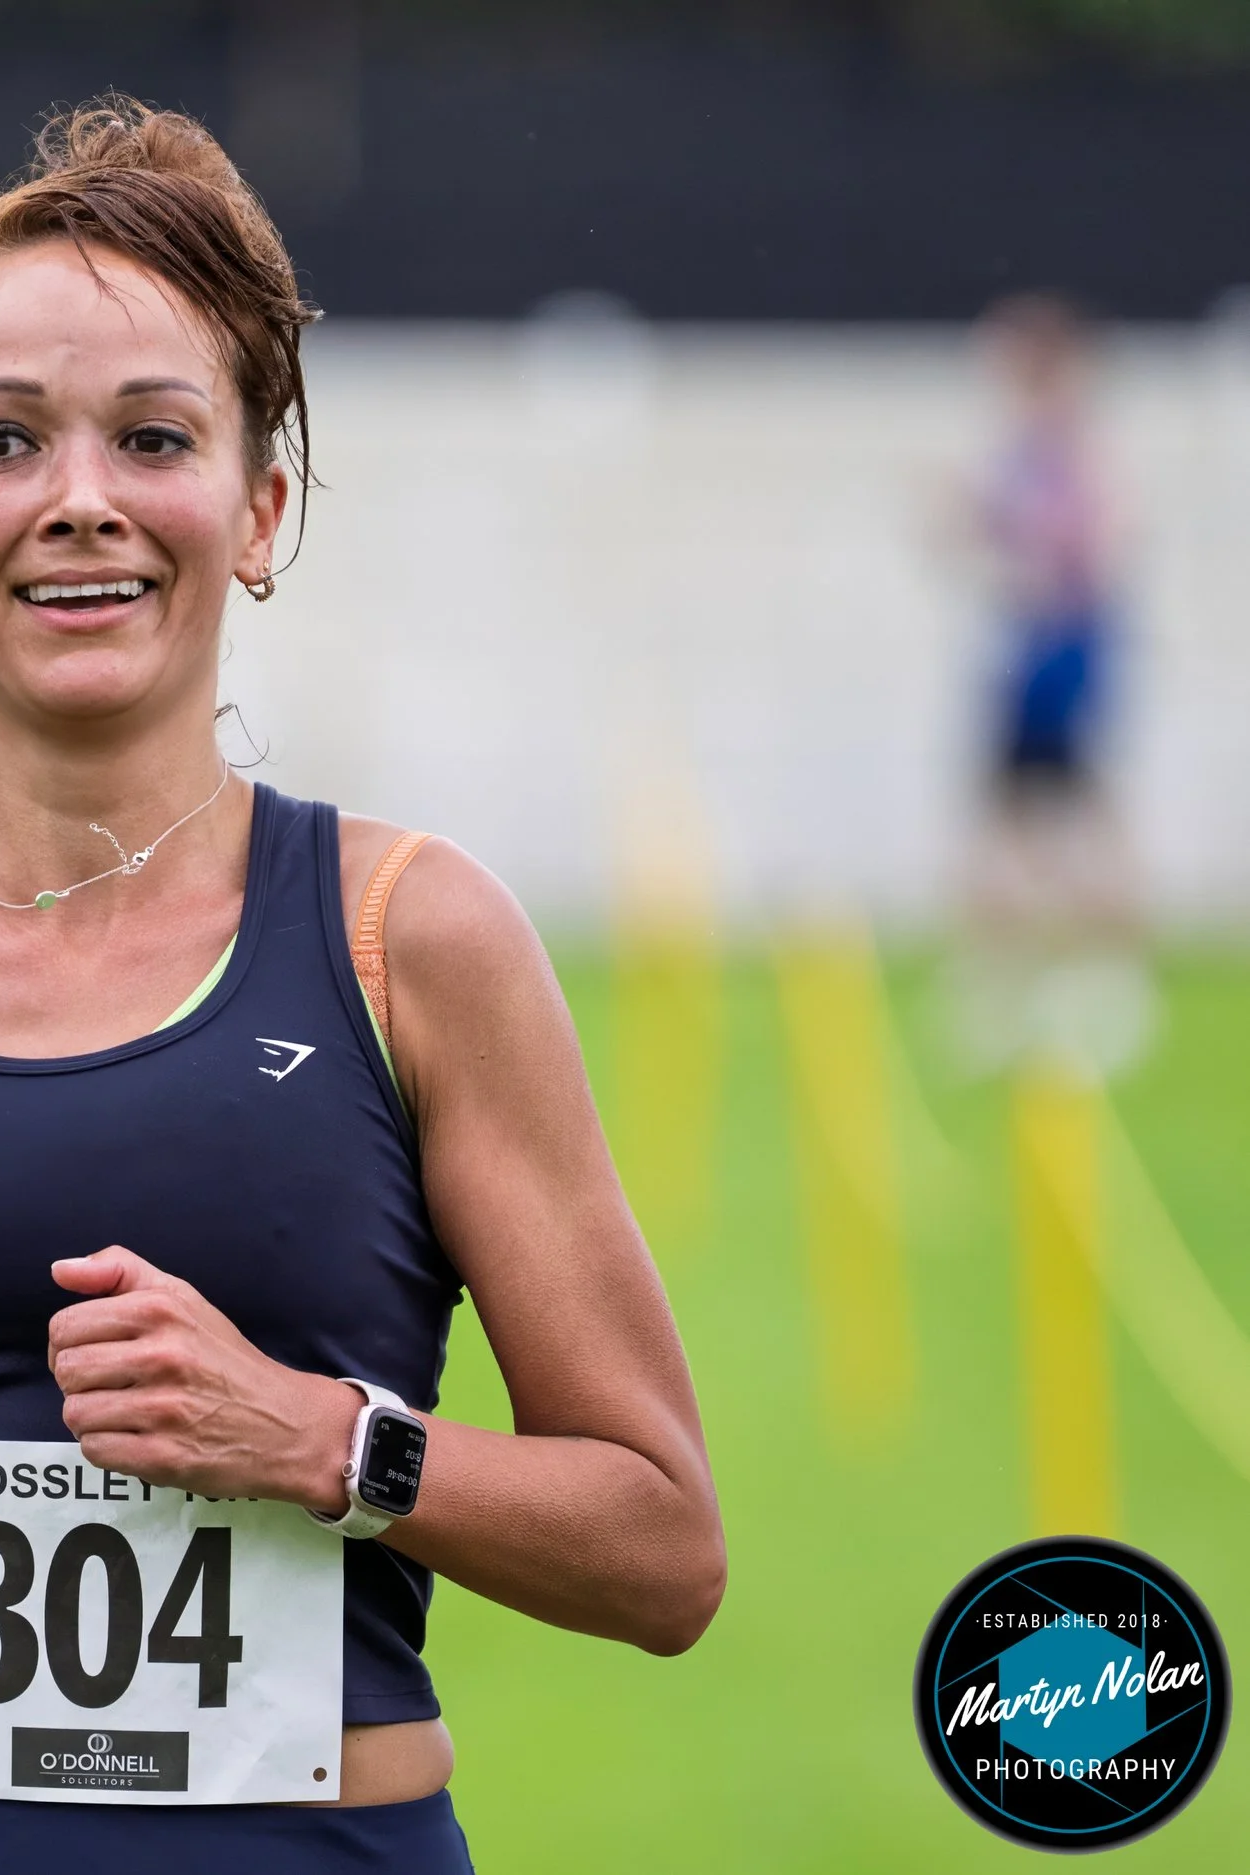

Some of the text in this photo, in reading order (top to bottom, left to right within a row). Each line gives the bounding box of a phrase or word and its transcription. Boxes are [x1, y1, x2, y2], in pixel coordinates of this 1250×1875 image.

[405, 1449, 422, 1462] 8:02
[40, 1752, 160, 1773] O'DONNELL
[61, 1776, 133, 1787] SOLICITORS
